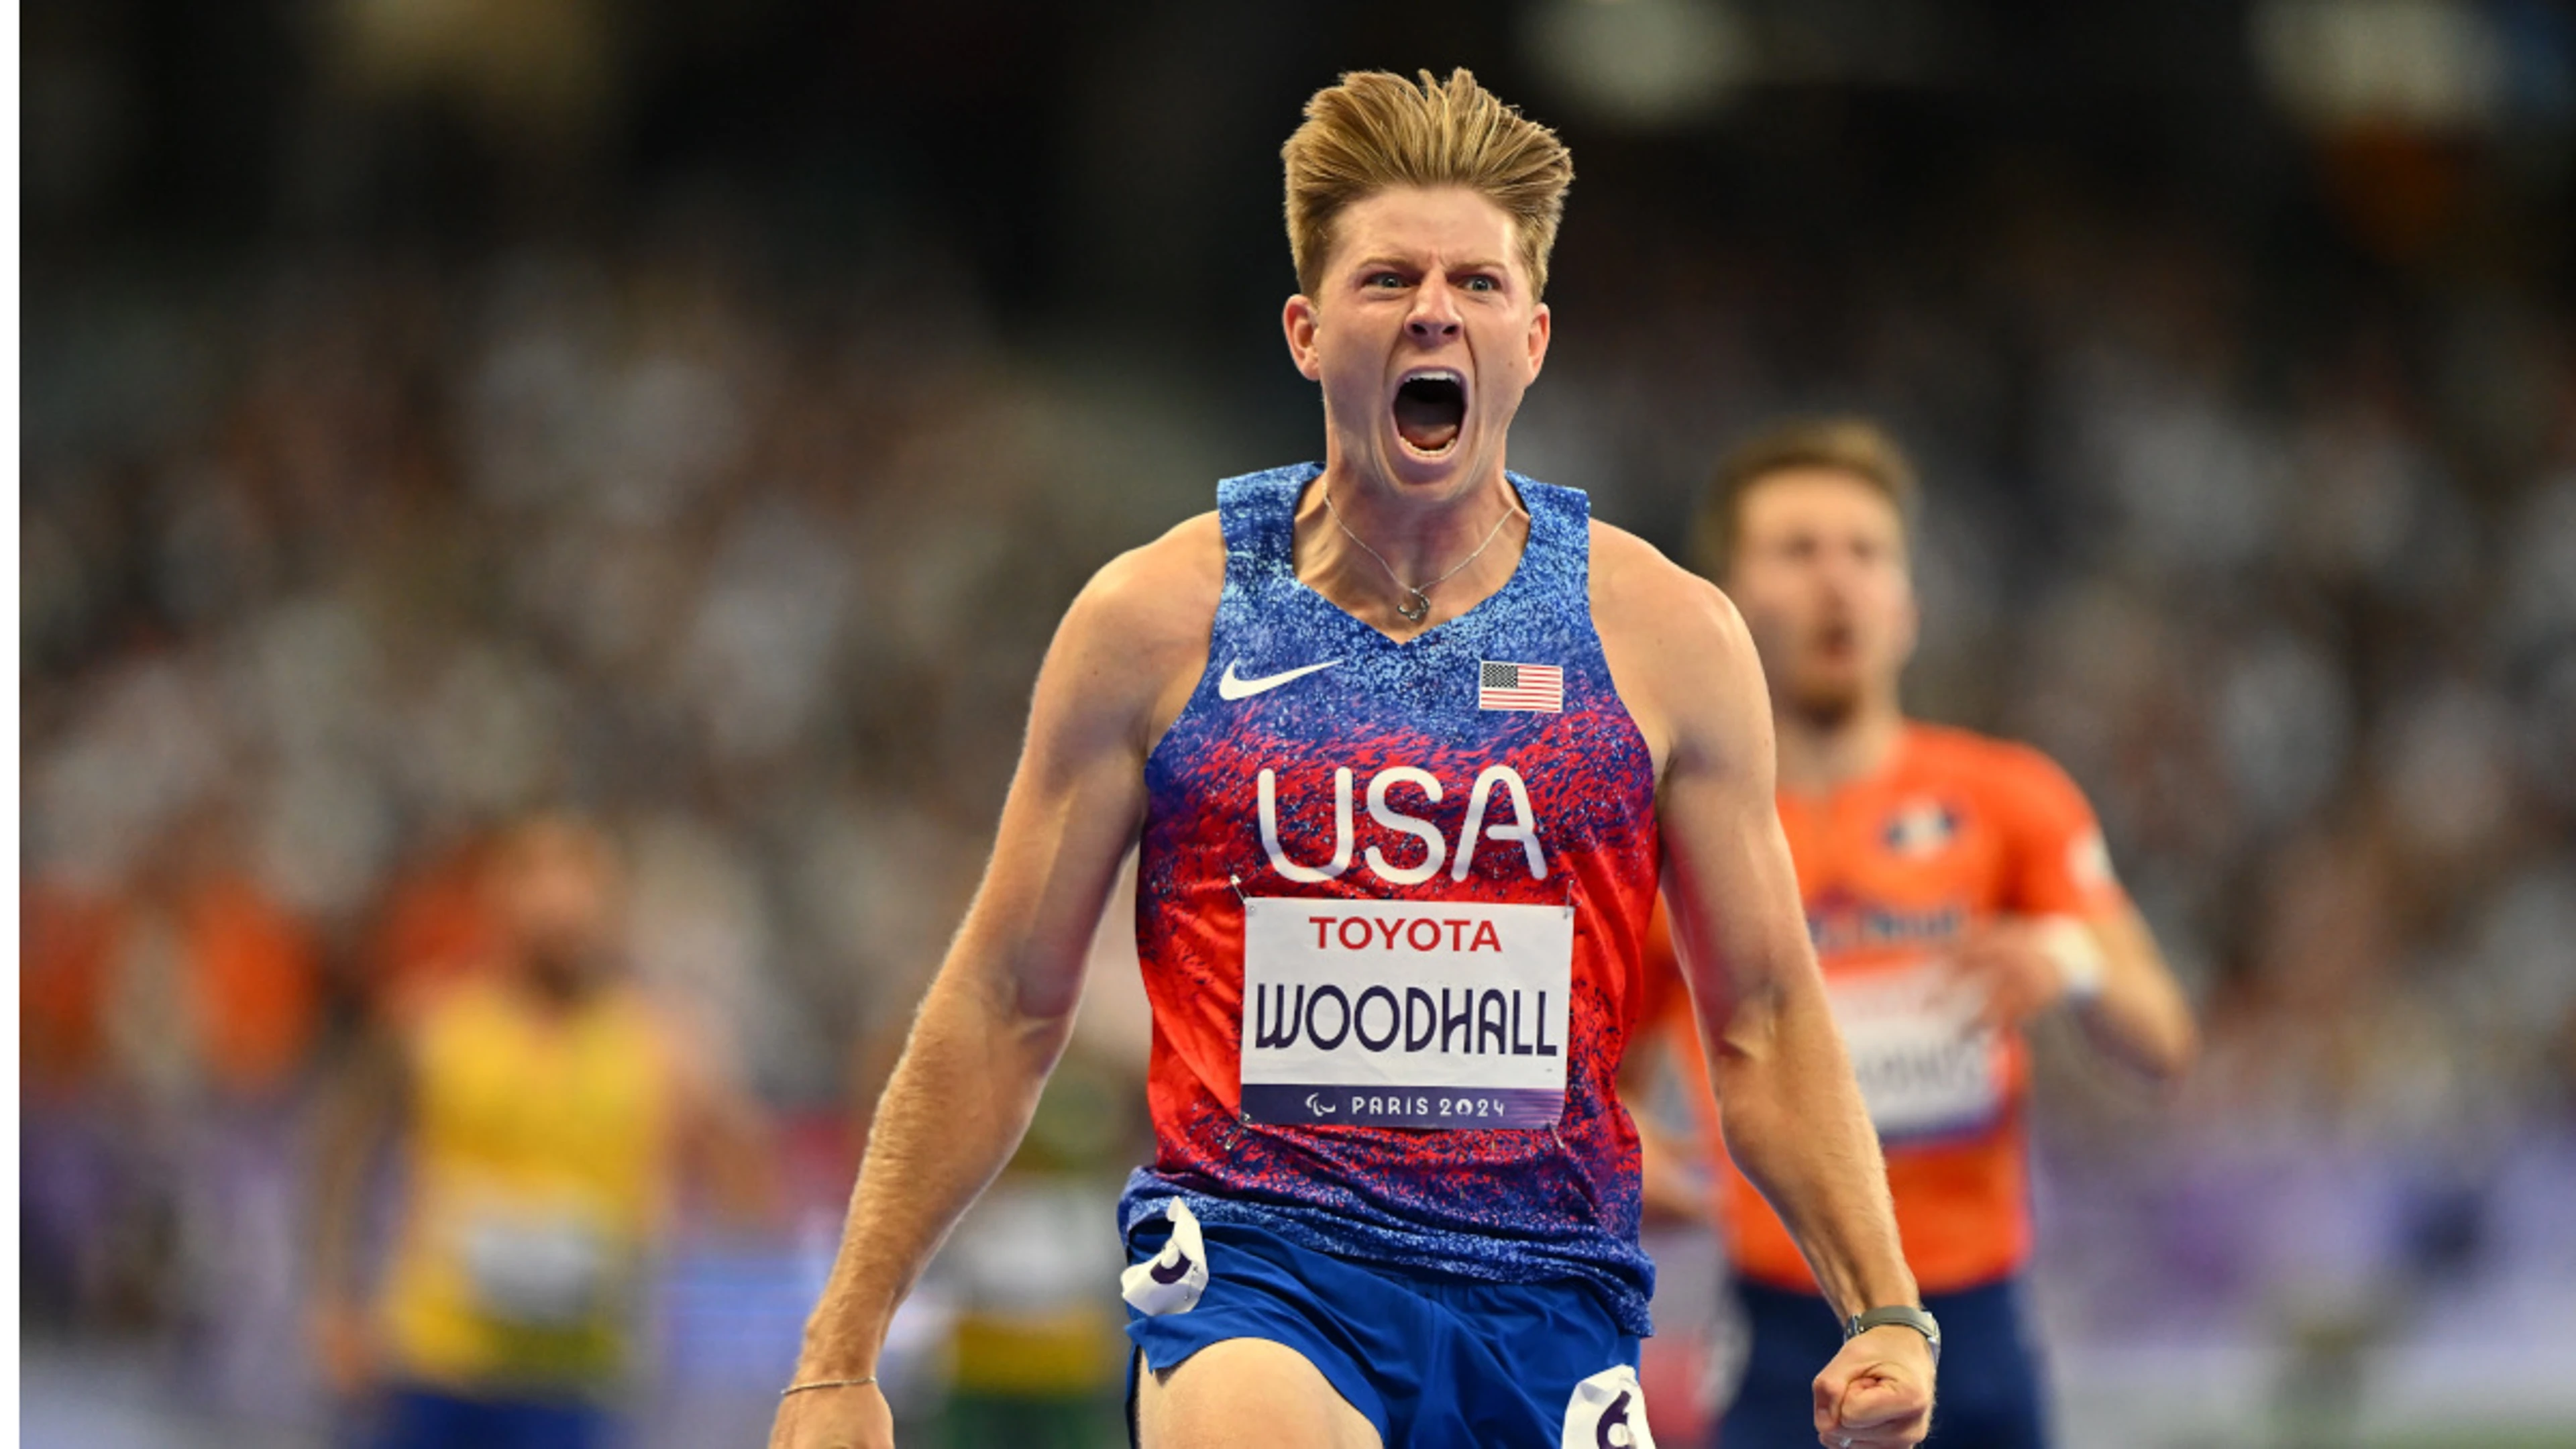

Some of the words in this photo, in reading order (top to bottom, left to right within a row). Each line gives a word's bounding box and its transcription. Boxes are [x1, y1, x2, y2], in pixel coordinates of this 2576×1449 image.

[1256, 765, 1548, 883] USA
[1309, 916, 1502, 952] TOYOTA
[1255, 983, 1558, 1056] WOODHALL
[1351, 1096, 1429, 1116] PARIS
[1440, 1097, 1505, 1118] 2024
